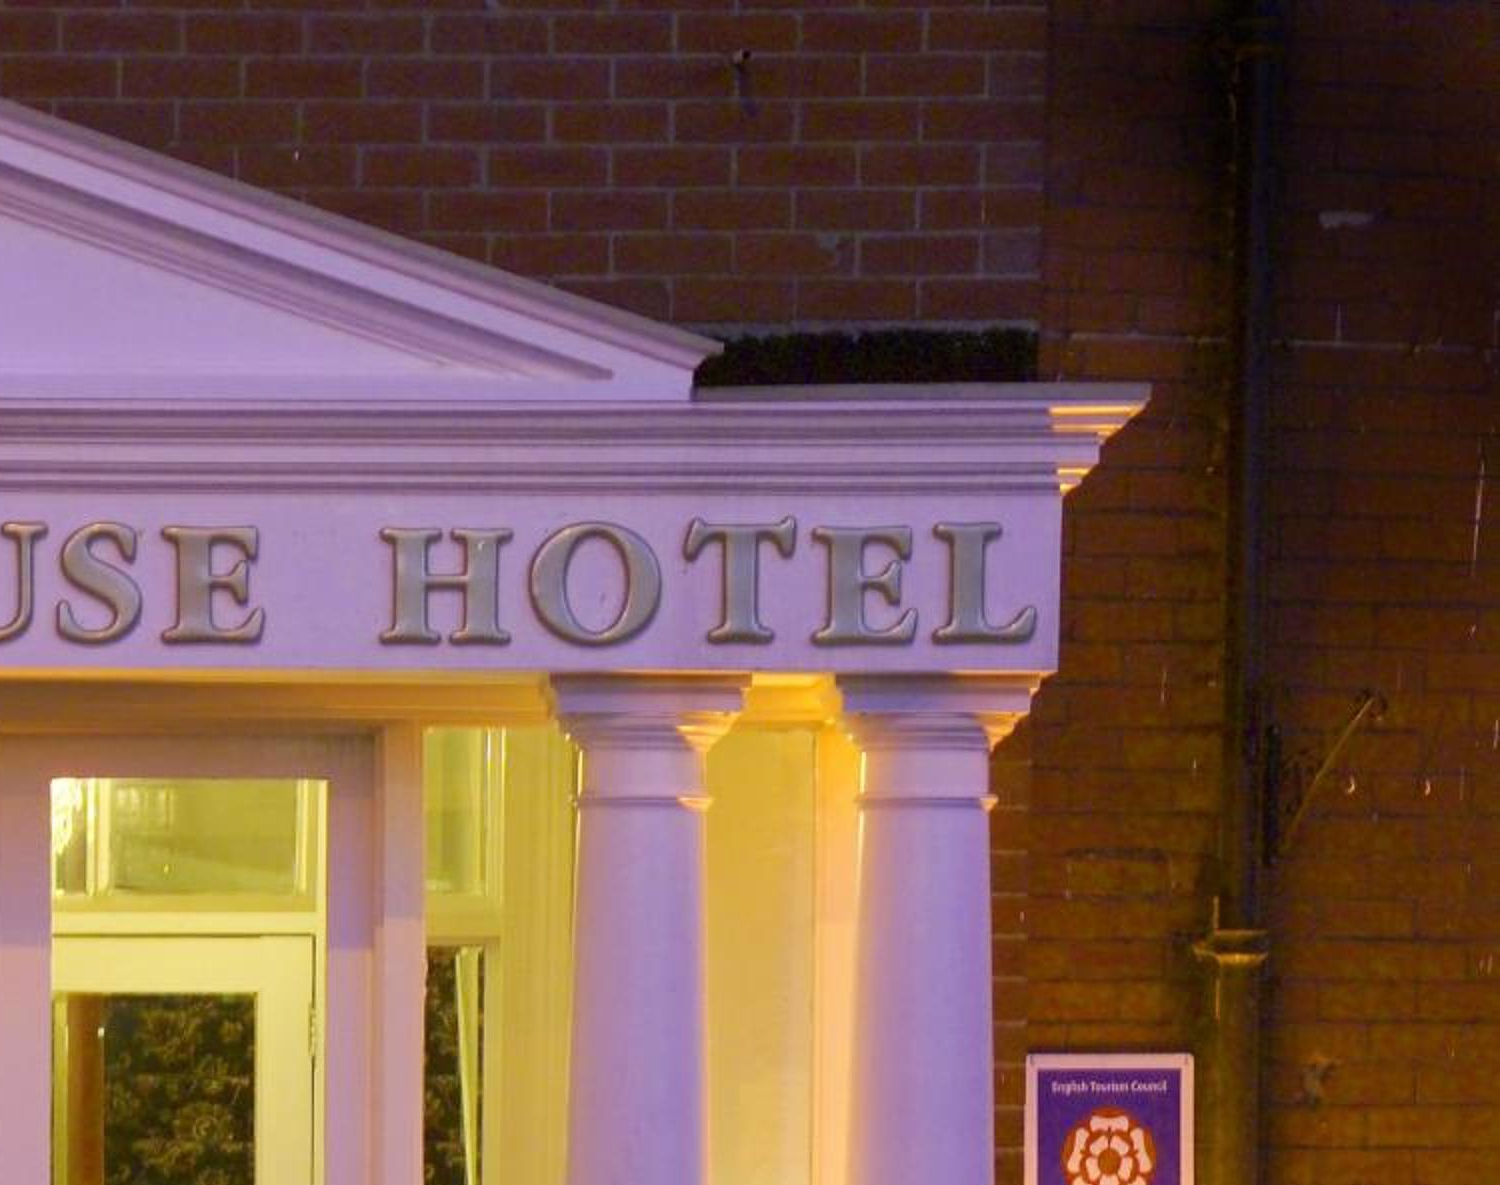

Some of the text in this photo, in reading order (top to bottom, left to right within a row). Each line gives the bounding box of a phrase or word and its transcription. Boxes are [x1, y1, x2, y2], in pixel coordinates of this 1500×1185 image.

[379, 516, 1037, 647] HOTEL
[1051, 1081, 1088, 1096] English
[1131, 1080, 1167, 1093] Council
